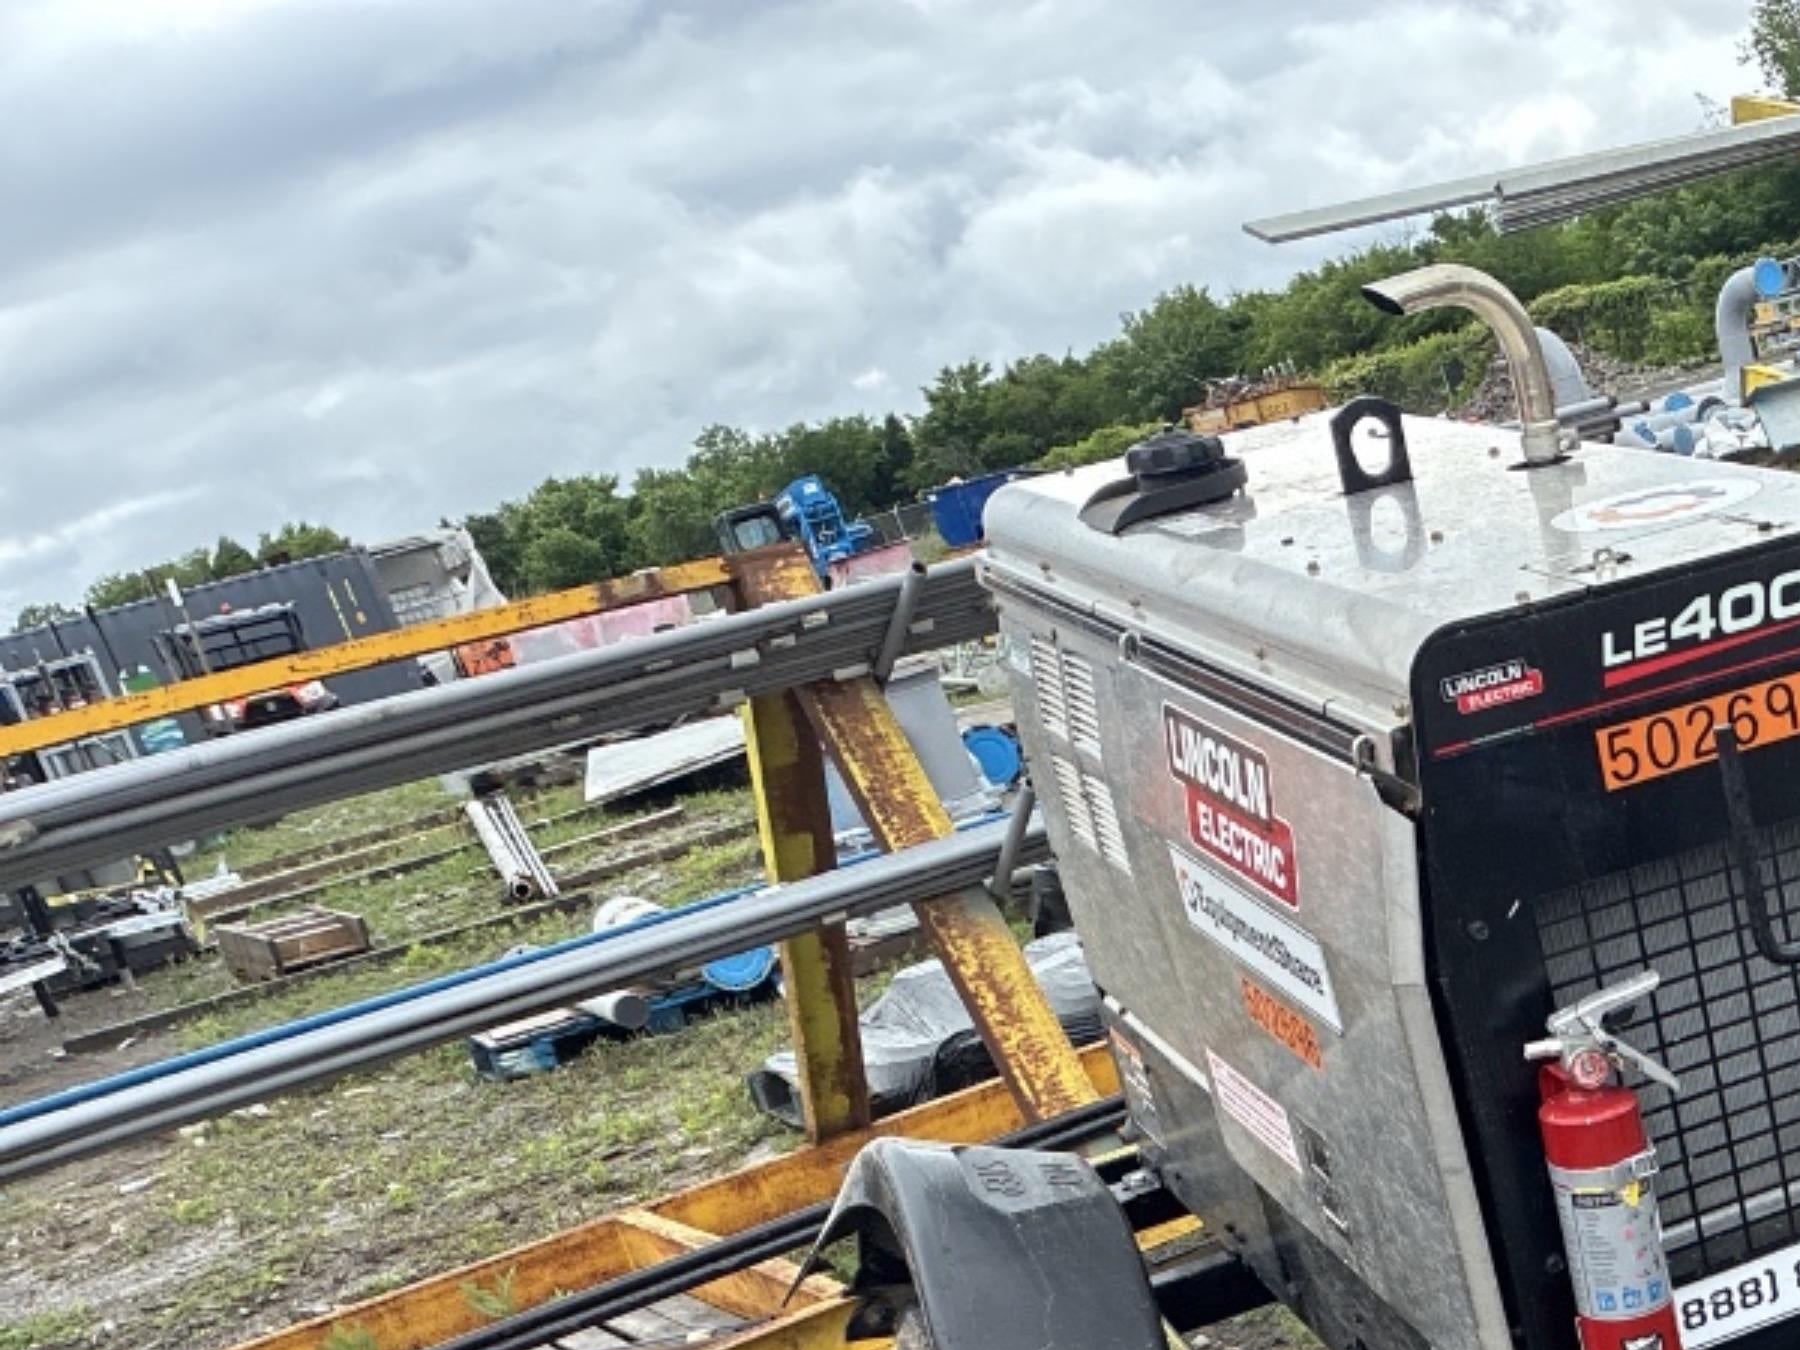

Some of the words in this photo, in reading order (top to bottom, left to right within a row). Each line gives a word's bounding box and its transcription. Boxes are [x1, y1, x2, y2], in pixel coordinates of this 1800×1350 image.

[1445, 664, 1522, 697] LINCOLN
[1469, 680, 1534, 712] ELECTRIC
[1168, 716, 1270, 820] LINCOLN
[1197, 799, 1287, 889] ELECTRIC
